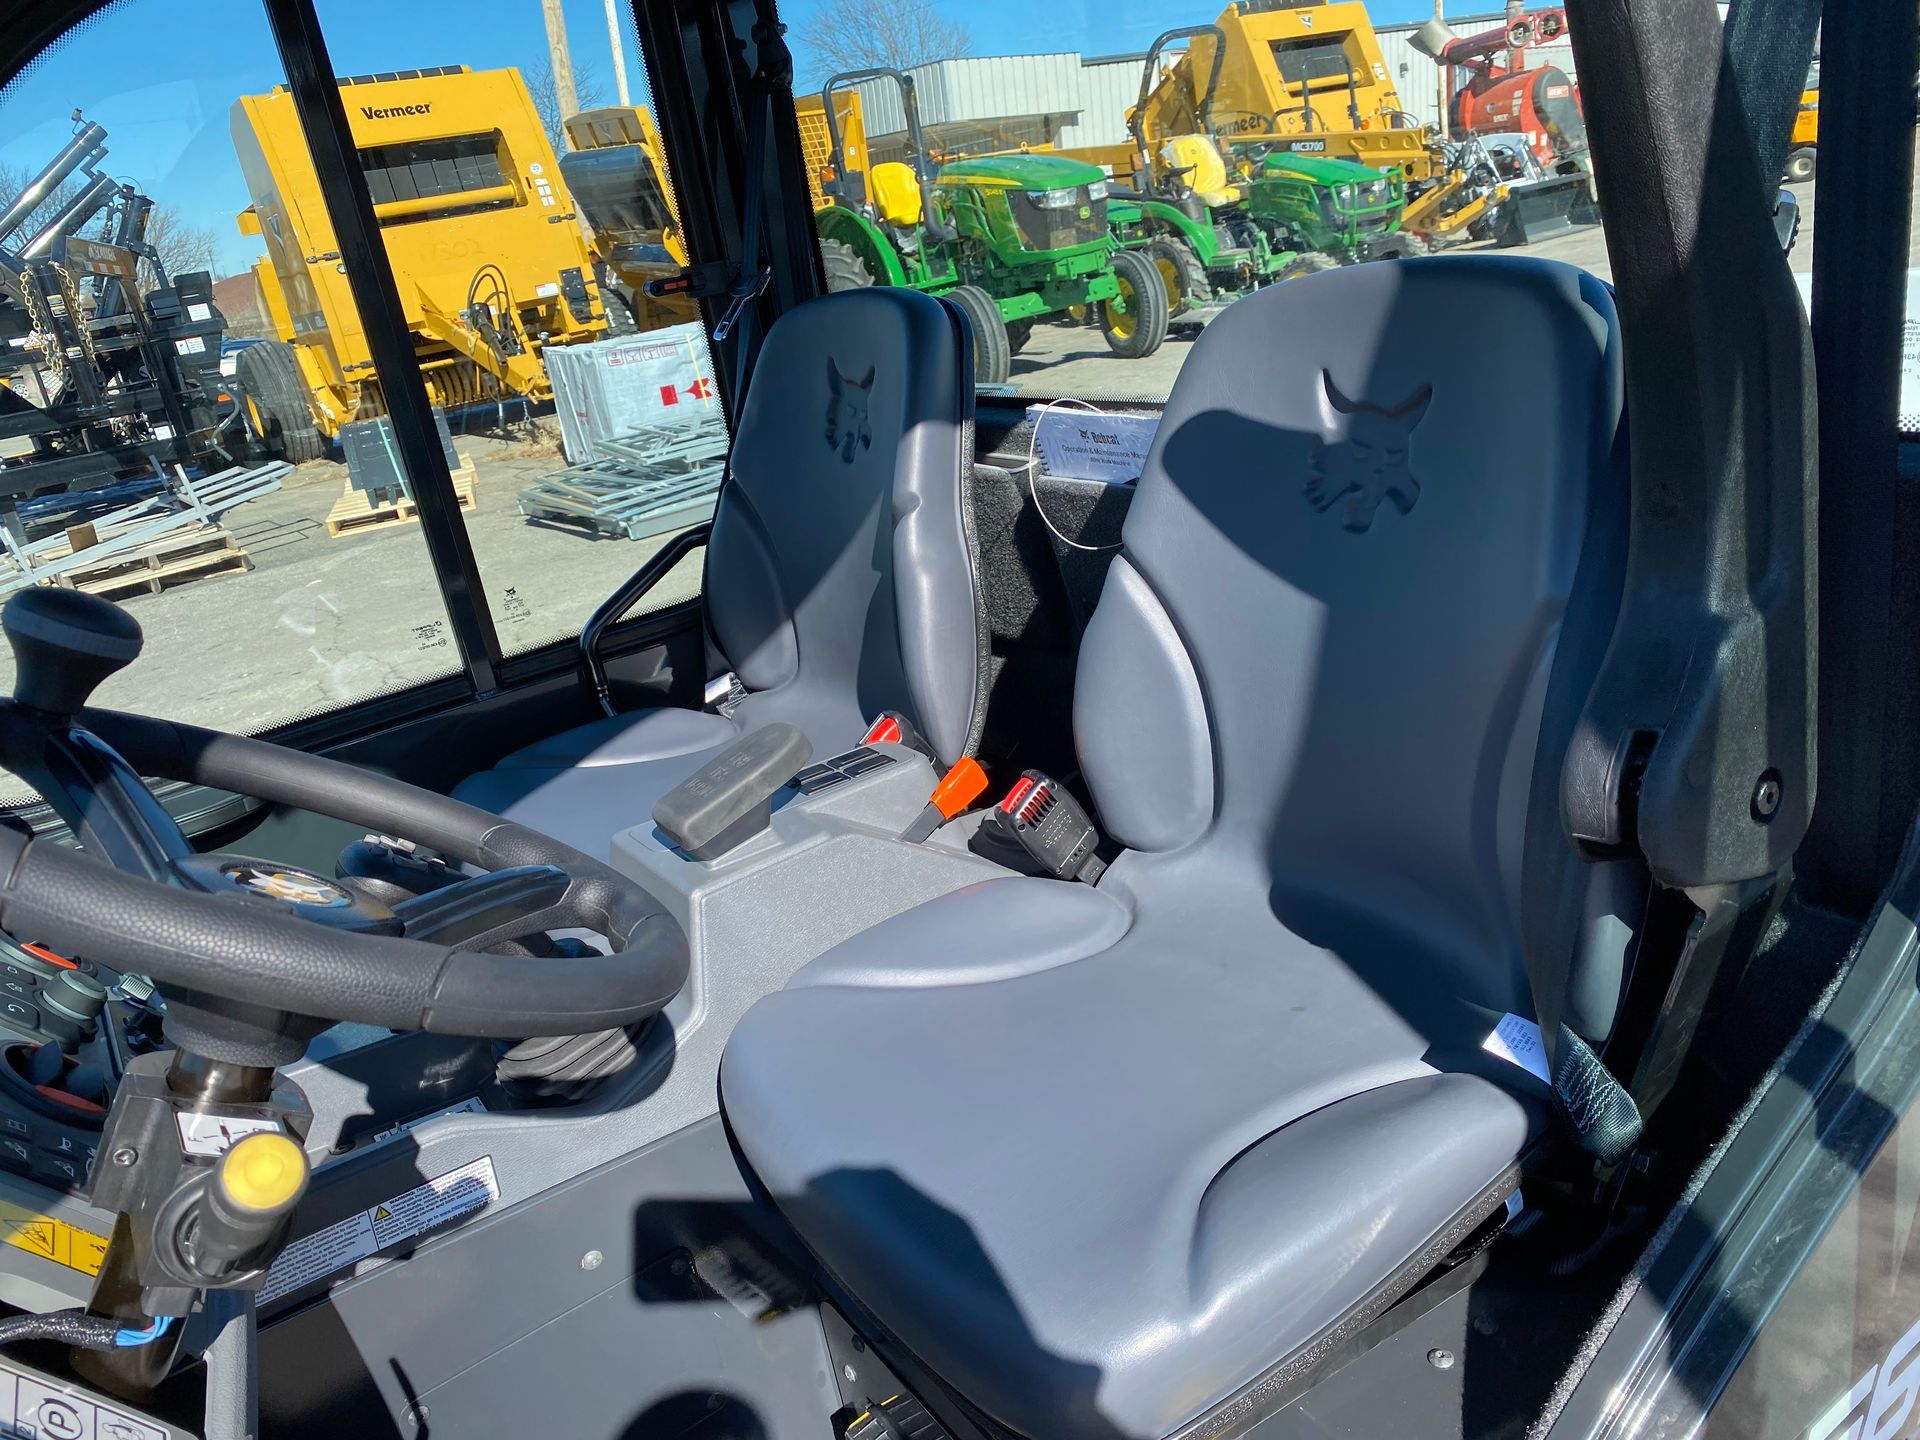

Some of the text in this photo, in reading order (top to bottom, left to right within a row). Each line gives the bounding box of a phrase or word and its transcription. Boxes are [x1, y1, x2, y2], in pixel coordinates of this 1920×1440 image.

[360, 103, 430, 119] Vermeer
[1215, 115, 1261, 136] ermeer
[1291, 142, 1323, 151] MC3700
[1091, 432, 1121, 445] Bobcat
[1062, 445, 1089, 453] Operation
[1094, 448, 1131, 458] Maintenance
